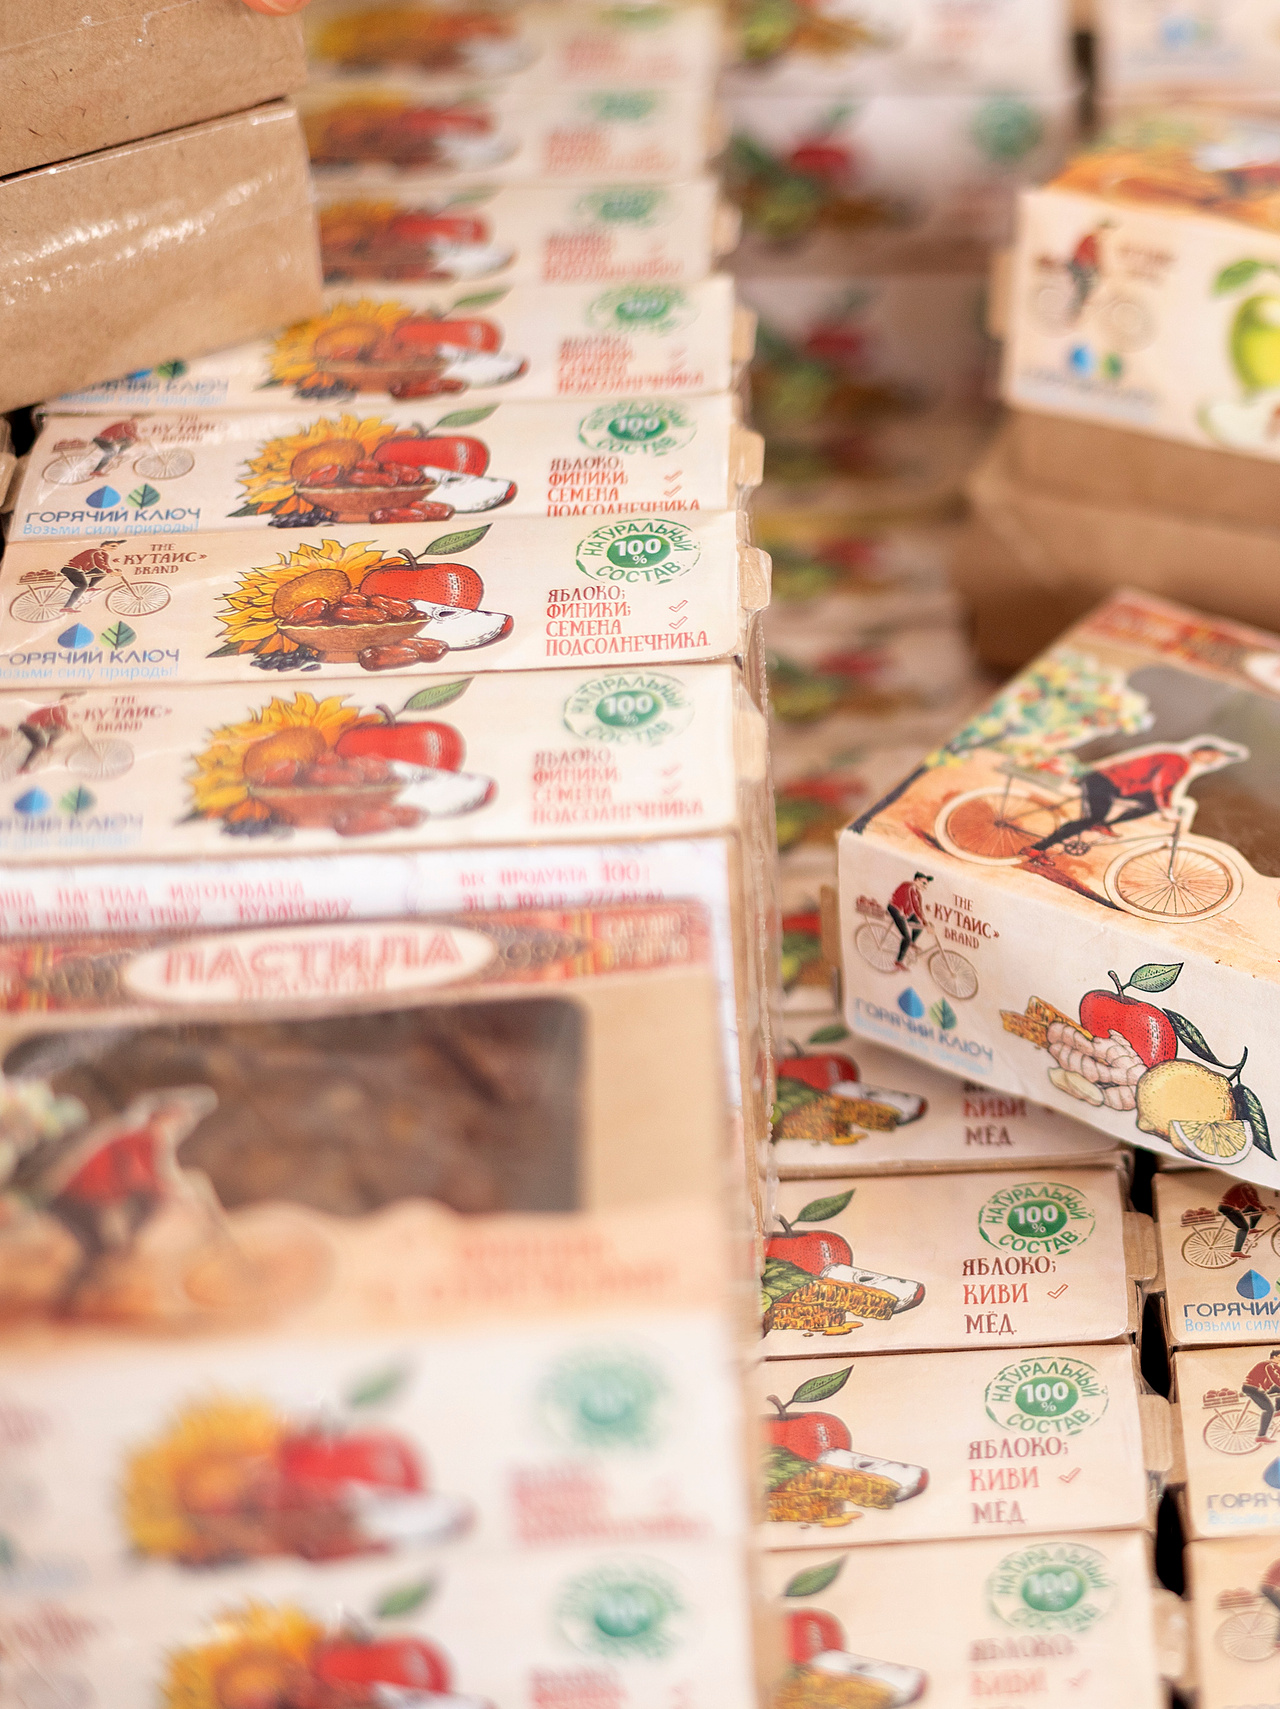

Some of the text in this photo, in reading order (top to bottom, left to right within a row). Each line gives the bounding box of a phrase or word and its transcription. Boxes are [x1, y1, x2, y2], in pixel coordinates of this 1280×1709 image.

[547, 486, 619, 502] СЕМЕНА
[26, 505, 201, 524] ГОРЯЧИЙ КЛЮЧ
[150, 542, 175, 552] THE
[582, 520, 698, 557] НАТУРАЛЬНЫЙ
[614, 537, 663, 557] 100
[133, 564, 179, 576] BRAND
[596, 560, 682, 584] СОСТАВ
[547, 585, 626, 603] ЯБЛОКО;
[545, 601, 632, 619] ФИНИКИ;
[545, 620, 622, 638] СЕМЕНА
[109, 648, 180, 663] КЛЮЧ
[603, 694, 654, 715] 100
[953, 893, 974, 912] THE
[944, 928, 980, 950] BRAND
[985, 1183, 1094, 1225] НАТУРАЛЬНЫЙ
[1013, 1205, 1058, 1224] 100
[998, 1230, 1080, 1254] СОСТАВ
[962, 1255, 1057, 1276] ЯБЛОКО;
[963, 1282, 1030, 1305] КИВИ
[1185, 1318, 1241, 1332] Возьми
[1245, 1319, 1279, 1334] силу
[990, 1359, 1108, 1404] НАТУРАЛЬНЫЙ
[1022, 1381, 1070, 1402] 100
[1006, 1408, 1092, 1436] СОСТАВ
[967, 1436, 1070, 1460] ЯБЛОКО;
[968, 1465, 1041, 1492] КИВИ
